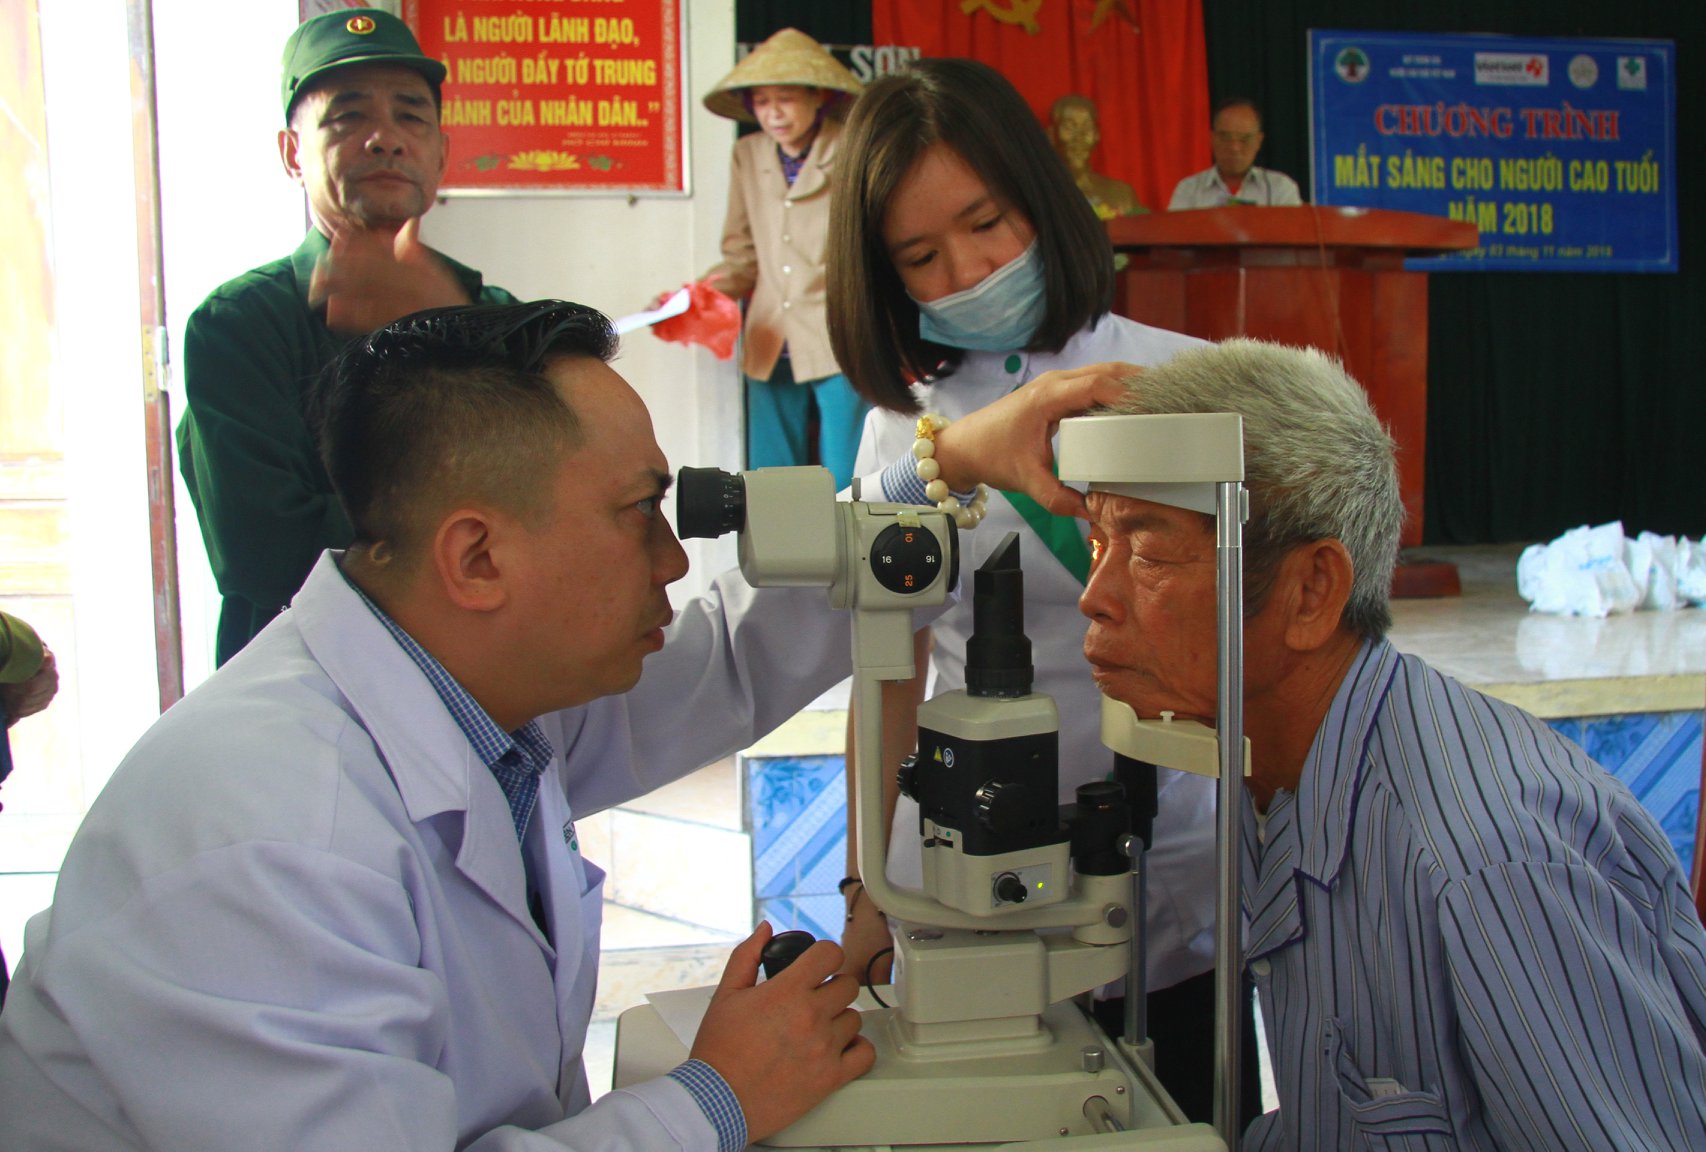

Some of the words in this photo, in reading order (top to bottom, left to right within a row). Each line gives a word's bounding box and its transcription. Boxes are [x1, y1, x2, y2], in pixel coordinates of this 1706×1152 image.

[444, 11, 468, 42] LÀ
[473, 10, 533, 42] NGƯỜI
[539, 12, 589, 43] LÃNH
[594, 18, 639, 50] ĐẠO,
[441, 52, 452, 84] À
[457, 51, 516, 84] NGƯỜI
[564, 51, 589, 85] TỚ
[593, 58, 657, 86] TRUNG
[441, 95, 490, 126] HÀNH
[497, 88, 534, 126] CỦA
[540, 95, 593, 127] NHÂN
[1374, 101, 1514, 138] CHƯƠNG
[1520, 100, 1620, 141] TRÌNH
[1387, 148, 1445, 189] SÁNG
[1452, 156, 1494, 190] CHO
[1500, 151, 1563, 191] NGƯỜI
[1569, 159, 1609, 192] CAO
[1503, 202, 1553, 234] 2018
[882, 555, 892, 563] 16
[904, 574, 913, 587] 25
